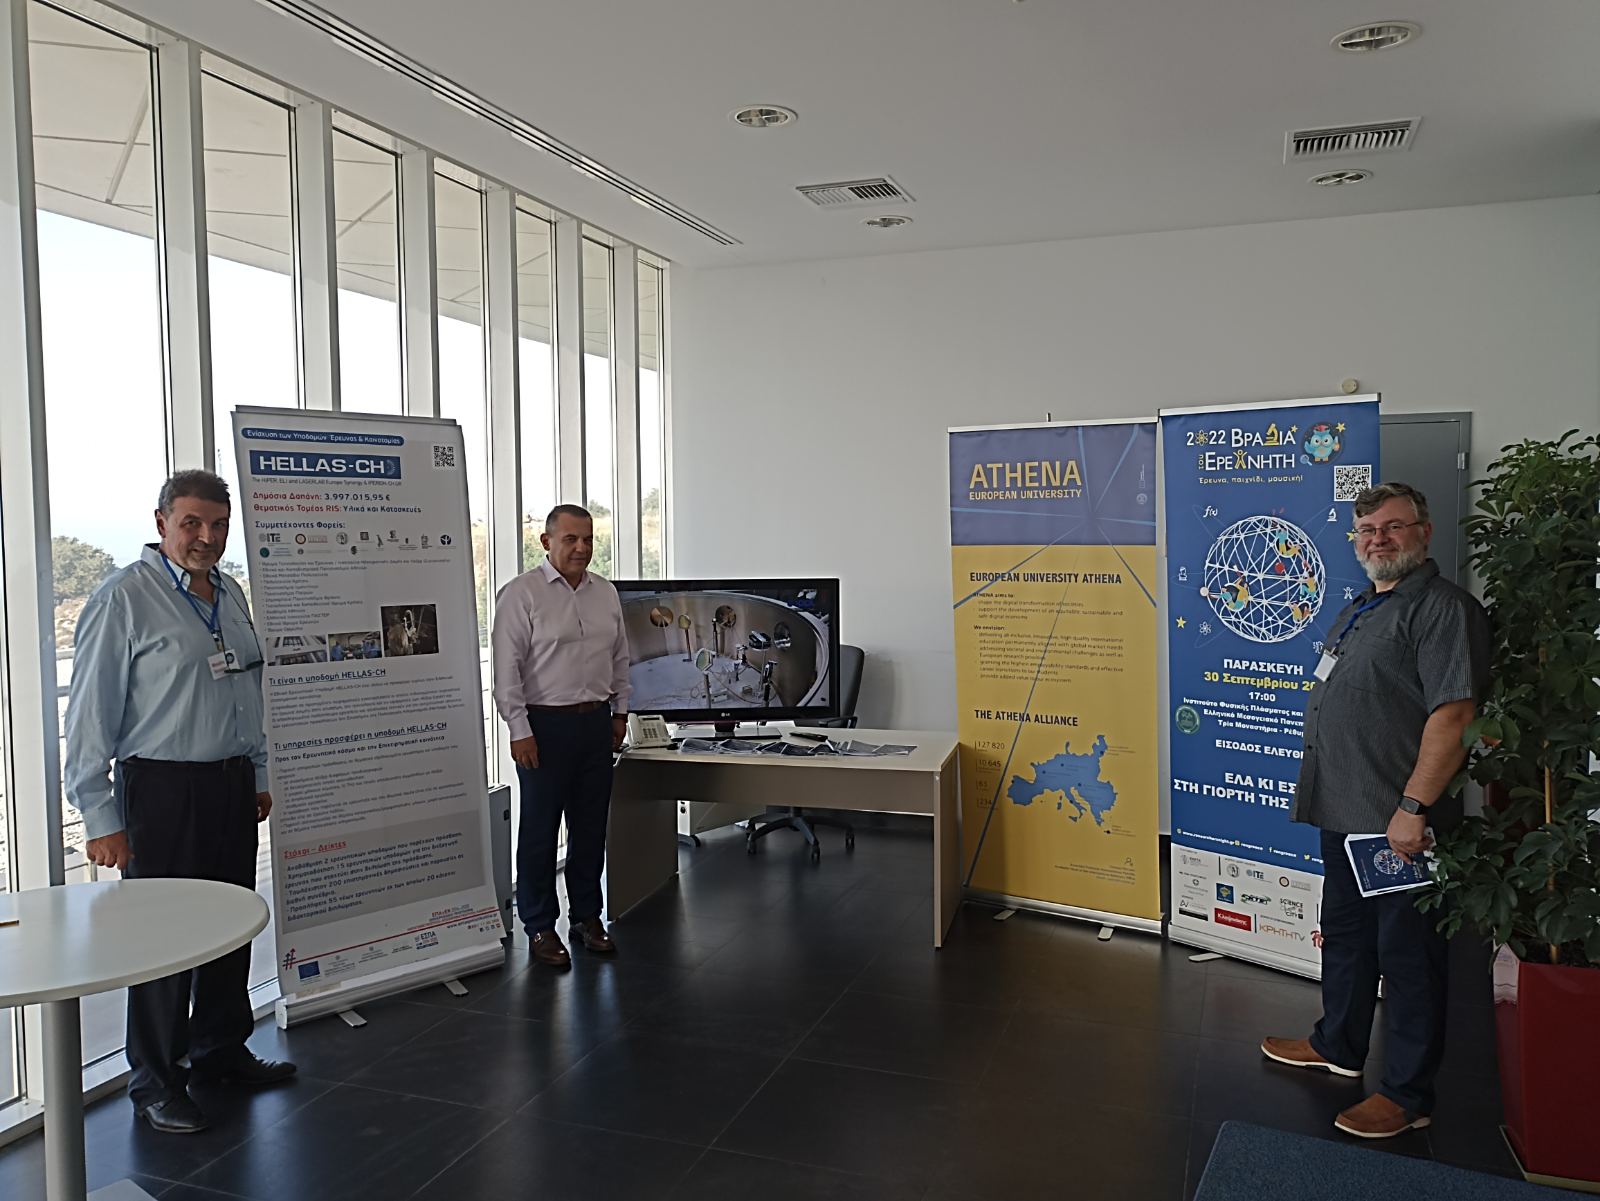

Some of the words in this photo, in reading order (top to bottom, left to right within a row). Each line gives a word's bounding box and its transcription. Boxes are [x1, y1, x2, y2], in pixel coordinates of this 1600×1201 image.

[259, 456, 384, 474] HELLAS-CH
[969, 459, 1083, 489] ATHENA
[253, 491, 287, 501] Δημόσια
[324, 493, 384, 501] 3.997.015,95
[969, 490, 1018, 500] EUROPEAN
[1020, 488, 1082, 500] UNIVERSITY
[255, 520, 314, 530] Συμμετέχοντες
[969, 572, 1020, 583] EUROPEAN
[1023, 573, 1079, 584] UNIVERSITY
[1082, 574, 1122, 584] ATHENA
[1223, 658, 1304, 676] ΠΑΡΑΣΚΕΥΗ
[341, 668, 386, 679] HELLAS-CH
[1204, 671, 1220, 682] 30
[1222, 673, 1299, 690] Σεπτεμβρίου
[1248, 691, 1276, 702] 17:00
[1203, 708, 1235, 719] Ελληνικό
[1219, 701, 1249, 711] Φυσικής
[1250, 704, 1290, 716] Πλάσματος
[974, 709, 993, 720] THE
[994, 711, 1032, 722] ATHENA
[1034, 714, 1079, 727] ALLIANCE
[1218, 719, 1234, 729] Τρία
[406, 721, 447, 733] HELLAS-CH
[1215, 739, 1262, 753] ΕΙΣΟΔΟΣ
[1224, 772, 1254, 787] ΕΛΑ
[1258, 777, 1274, 790] ΚΙ
[1173, 779, 1199, 794] ΣΤΗ
[1202, 784, 1255, 803] ΓΙΟΡΤΗ
[1259, 793, 1290, 810] ΤΗΣ
[329, 879, 342, 888] 200
